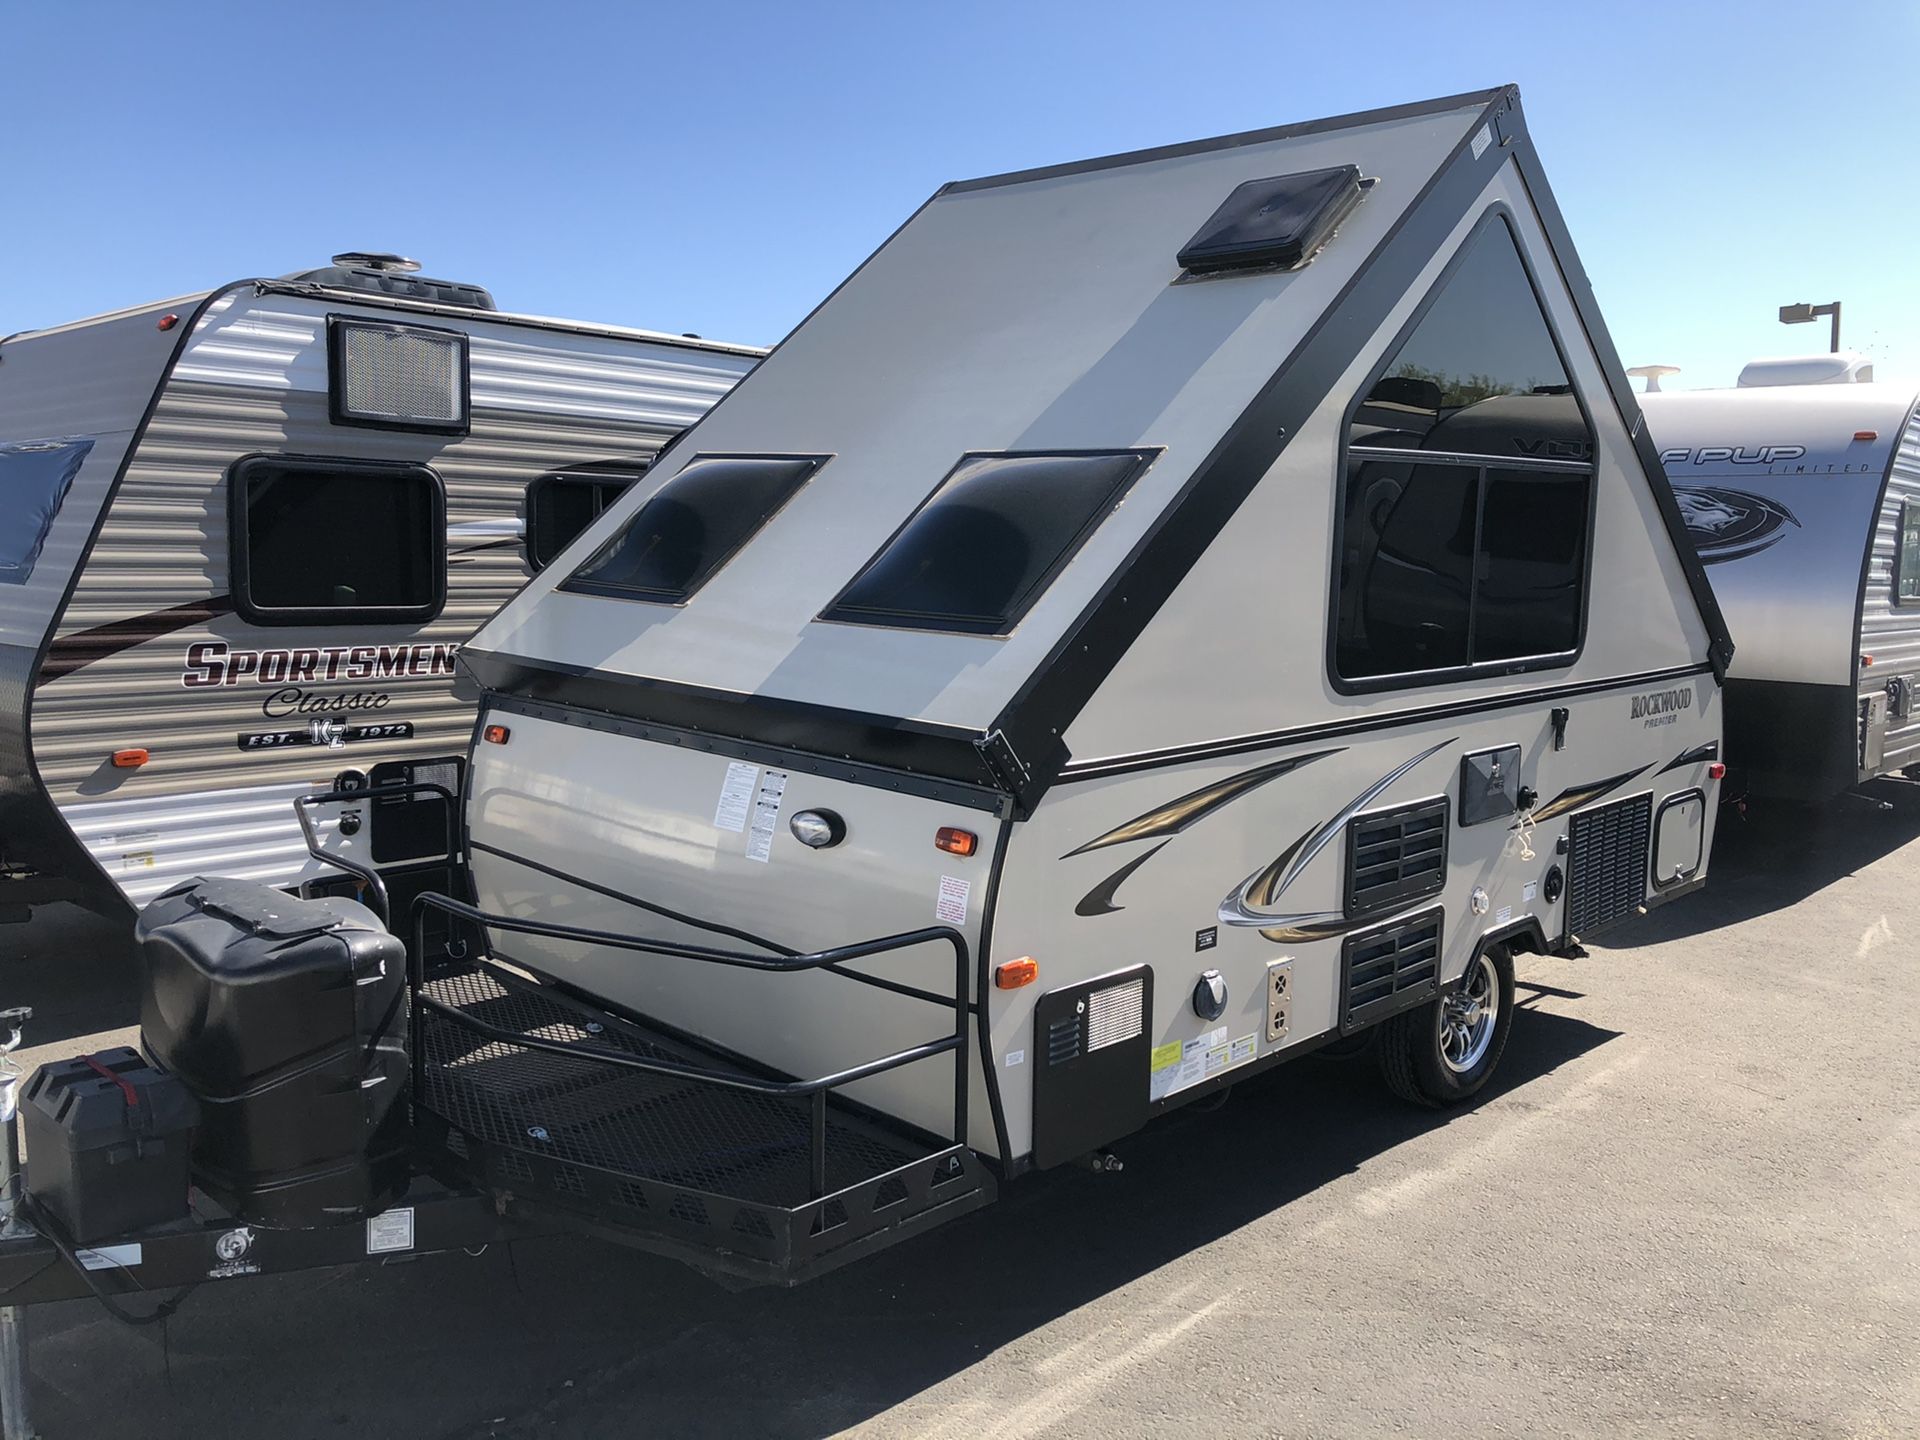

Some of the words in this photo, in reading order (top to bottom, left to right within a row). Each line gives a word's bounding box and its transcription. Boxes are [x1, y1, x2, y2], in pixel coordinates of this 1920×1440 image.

[1694, 446, 1806, 464] PUP
[1768, 463, 1870, 474] LIMITED
[182, 641, 460, 688] SPORTSMEN
[263, 687, 390, 718] Classic
[1630, 687, 1692, 719] ROCKWOOD
[1643, 714, 1677, 729] PREMIER
[248, 733, 294, 746] EST.
[359, 725, 407, 737] 1972
